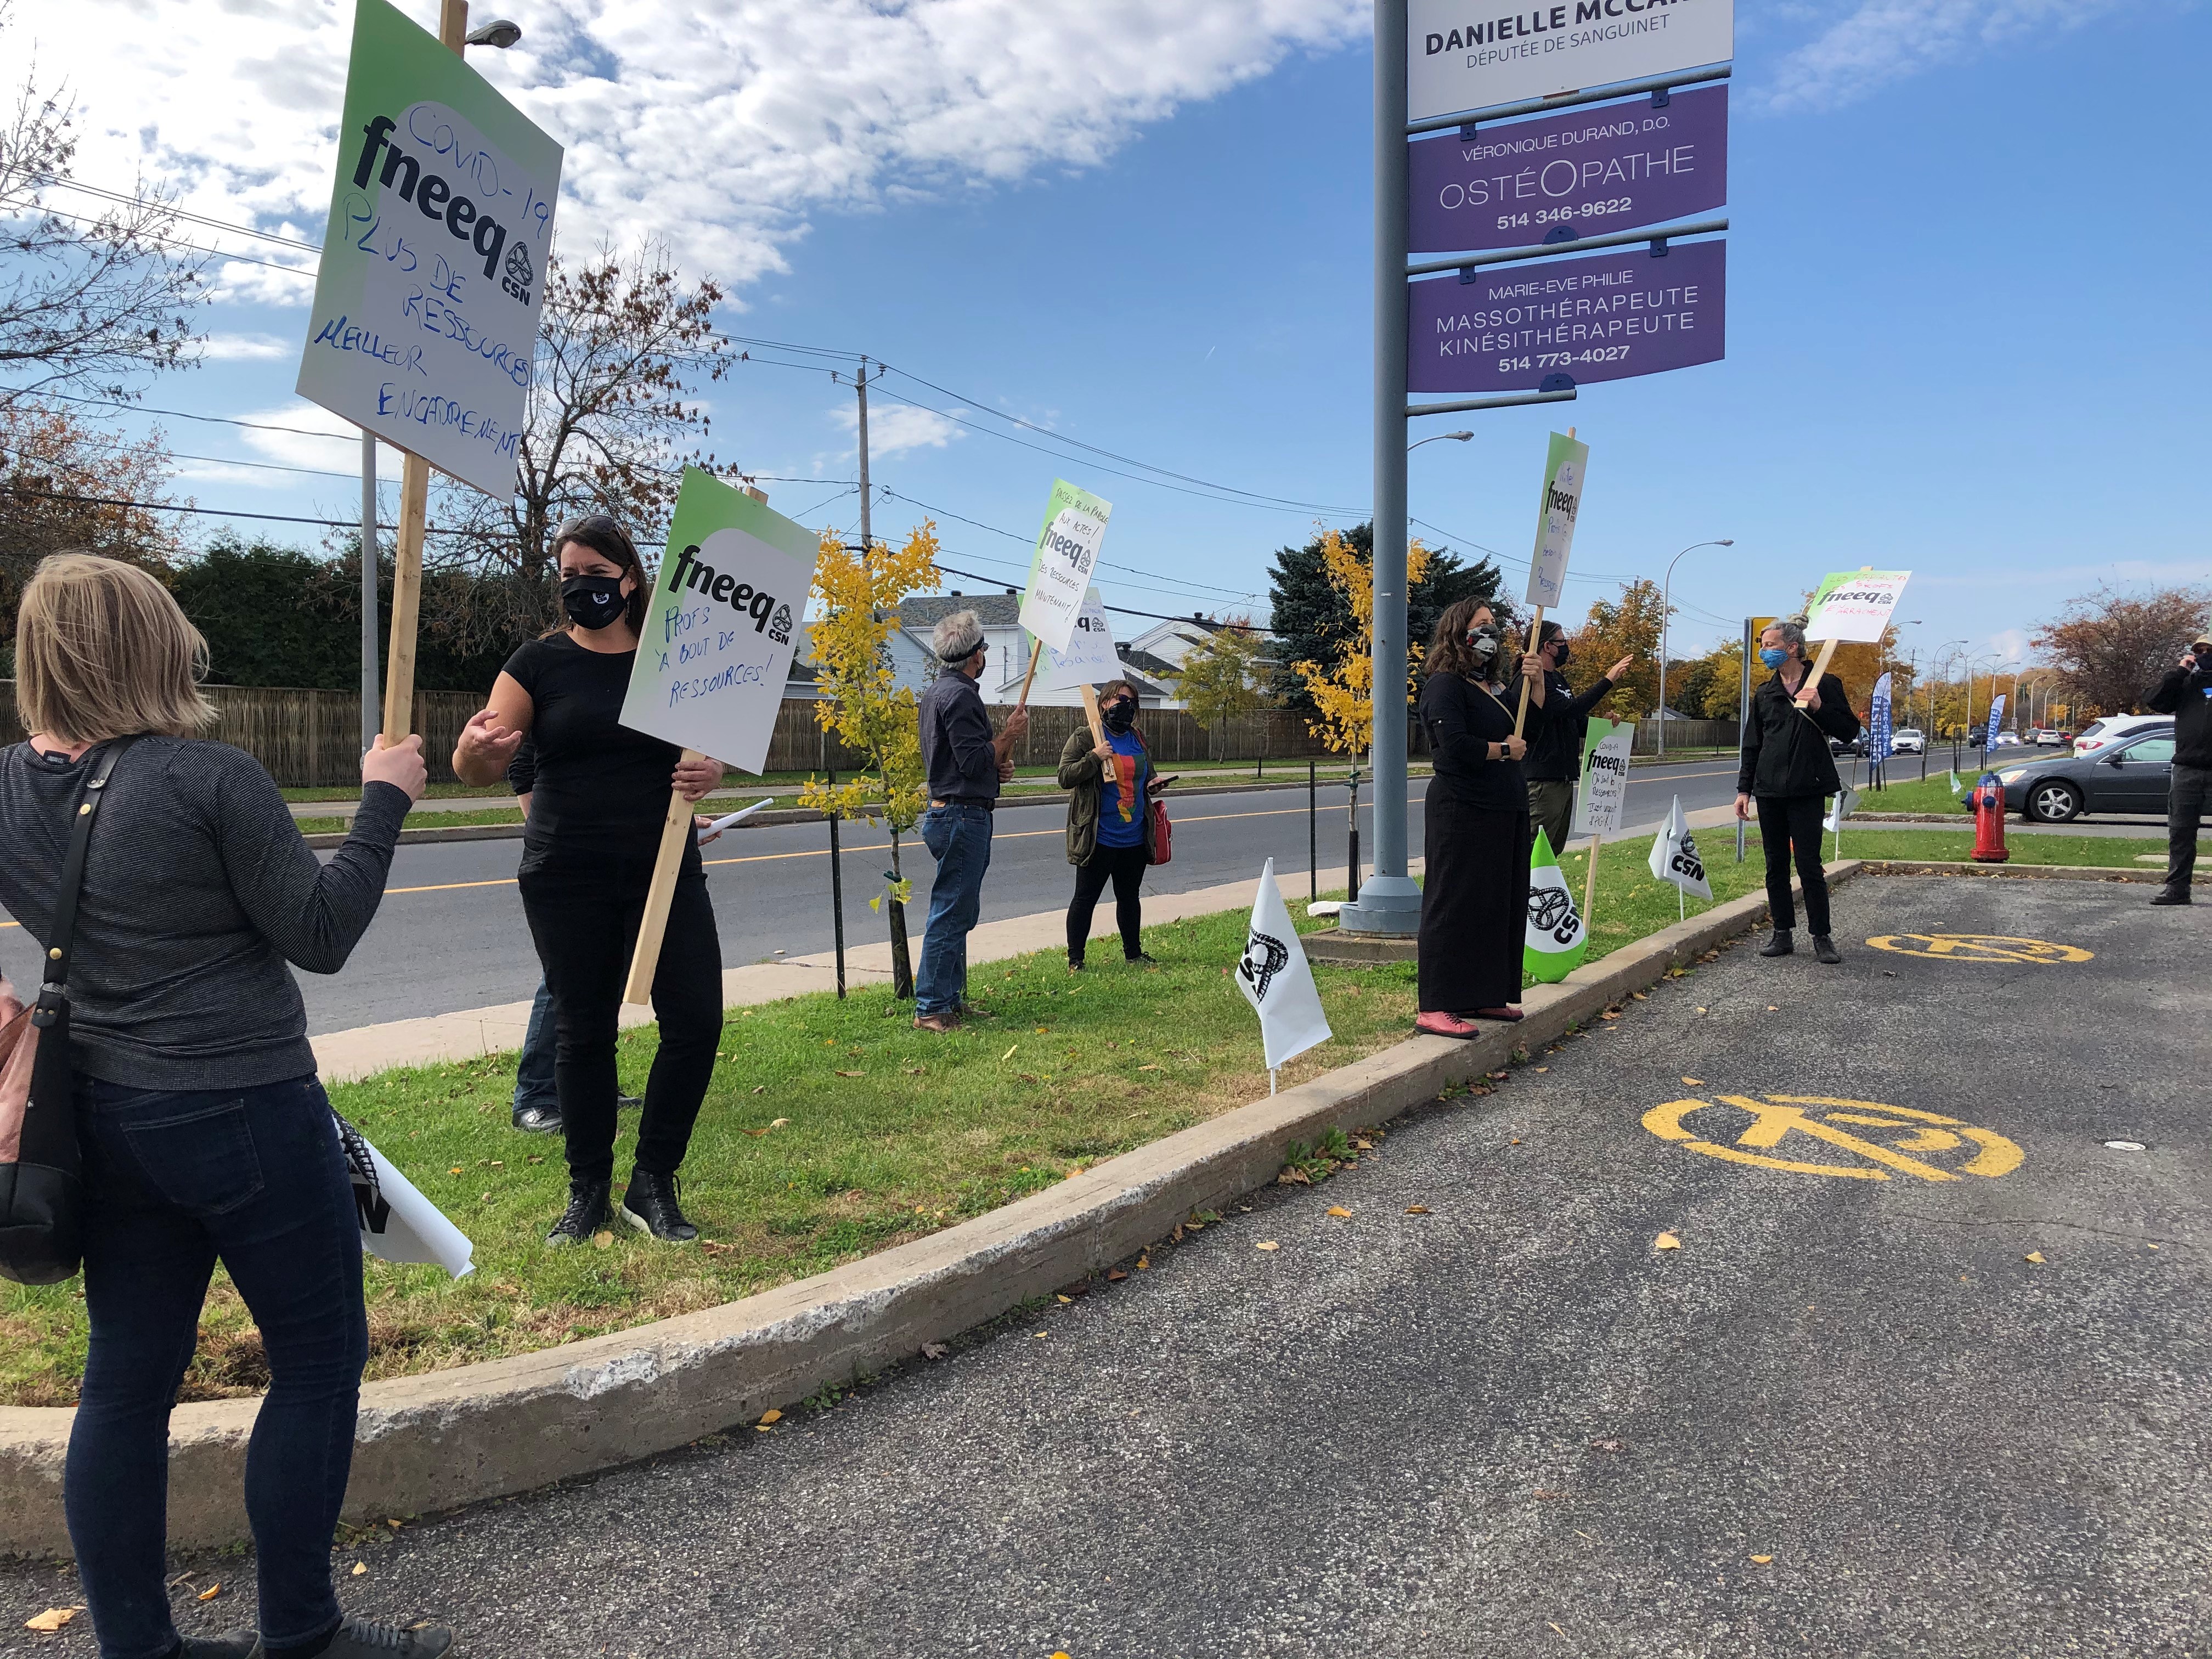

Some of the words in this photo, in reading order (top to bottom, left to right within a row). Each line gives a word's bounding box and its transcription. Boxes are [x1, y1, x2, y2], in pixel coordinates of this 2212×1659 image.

[1426, 5, 1566, 55] DANIELLE
[1466, 41, 1539, 69] DÉPUTÉE
[1543, 37, 1566, 53] DE
[1570, 13, 1671, 47] SANGUINET
[1462, 134, 1558, 162] VÉRONIQUE
[1562, 121, 1639, 145] DURAND,
[1643, 116, 1671, 131] D.O.
[409, 106, 549, 239] COVID-19
[1440, 144, 1695, 209] OSTÉOPATHE
[353, 115, 507, 281] fneeq
[1497, 212, 1530, 230] 514
[1535, 197, 1632, 224] 346-9622
[343, 192, 417, 272] PLUS
[430, 253, 466, 303] DE
[501, 275, 531, 307] CSN
[1488, 277, 1578, 301] MARIE-EVE
[1582, 270, 1634, 289] PHILIE
[1436, 286, 1699, 334] MASSOTHÉRAPEUTE
[313, 314, 427, 377] MEILLEUR
[403, 283, 529, 386] RESSOURCES
[1440, 312, 1695, 357] KINÉSITHÉRAPEUTE
[1498, 357, 1531, 373] 514
[1537, 345, 1630, 368] 773-4027
[1055, 487, 1073, 504] PASSEZ
[1074, 500, 1082, 509] DE
[1082, 504, 1090, 513] LA
[1090, 506, 1109, 525] PAROLE
[1059, 512, 1070, 526] AUX
[1545, 480, 1574, 521] fneeq
[1039, 521, 1084, 568] fneeq
[1038, 558, 1048, 574] DES
[1077, 565, 1088, 575] CSN
[668, 545, 776, 634] fneeq
[1817, 591, 1880, 606] fneeq
[665, 605, 710, 644] PROFS
[768, 629, 789, 646] CSN
[679, 637, 710, 664] BOUT
[718, 631, 735, 651] DE
[1586, 749, 1620, 775] fneeq
[1671, 855, 1705, 882] CSN
